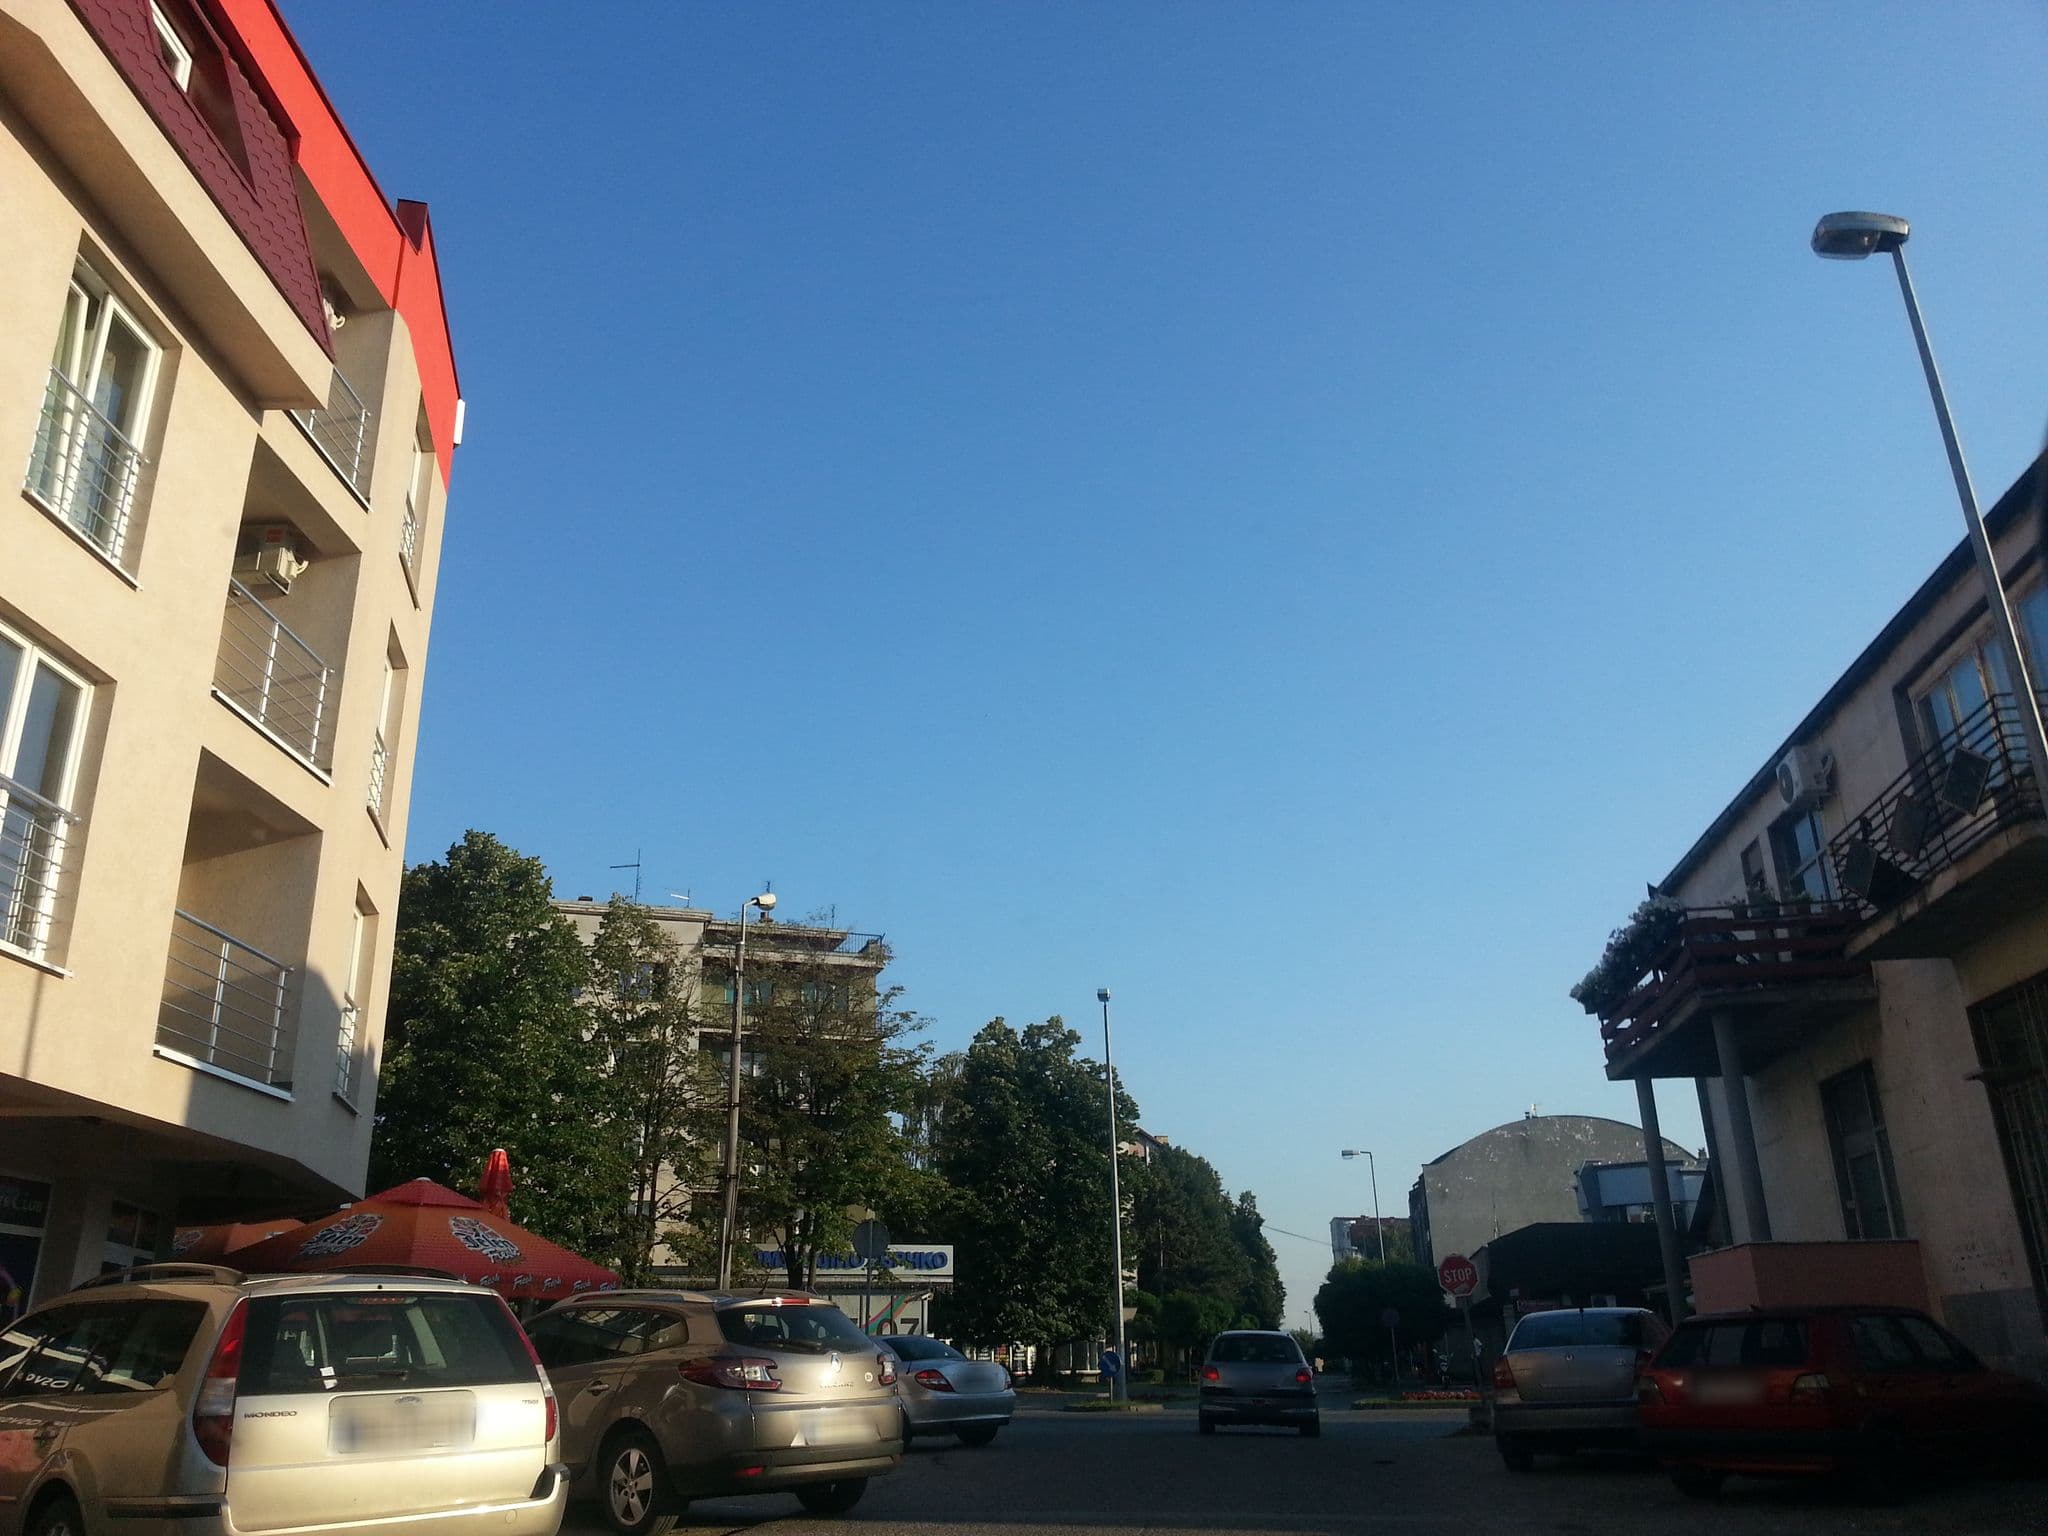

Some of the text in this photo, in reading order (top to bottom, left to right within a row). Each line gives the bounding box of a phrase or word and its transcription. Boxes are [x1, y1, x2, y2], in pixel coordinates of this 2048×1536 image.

[454, 1230, 516, 1251] Jelen
[1443, 1267, 1472, 1283] STOP
[244, 1410, 297, 1419] MONDEO
